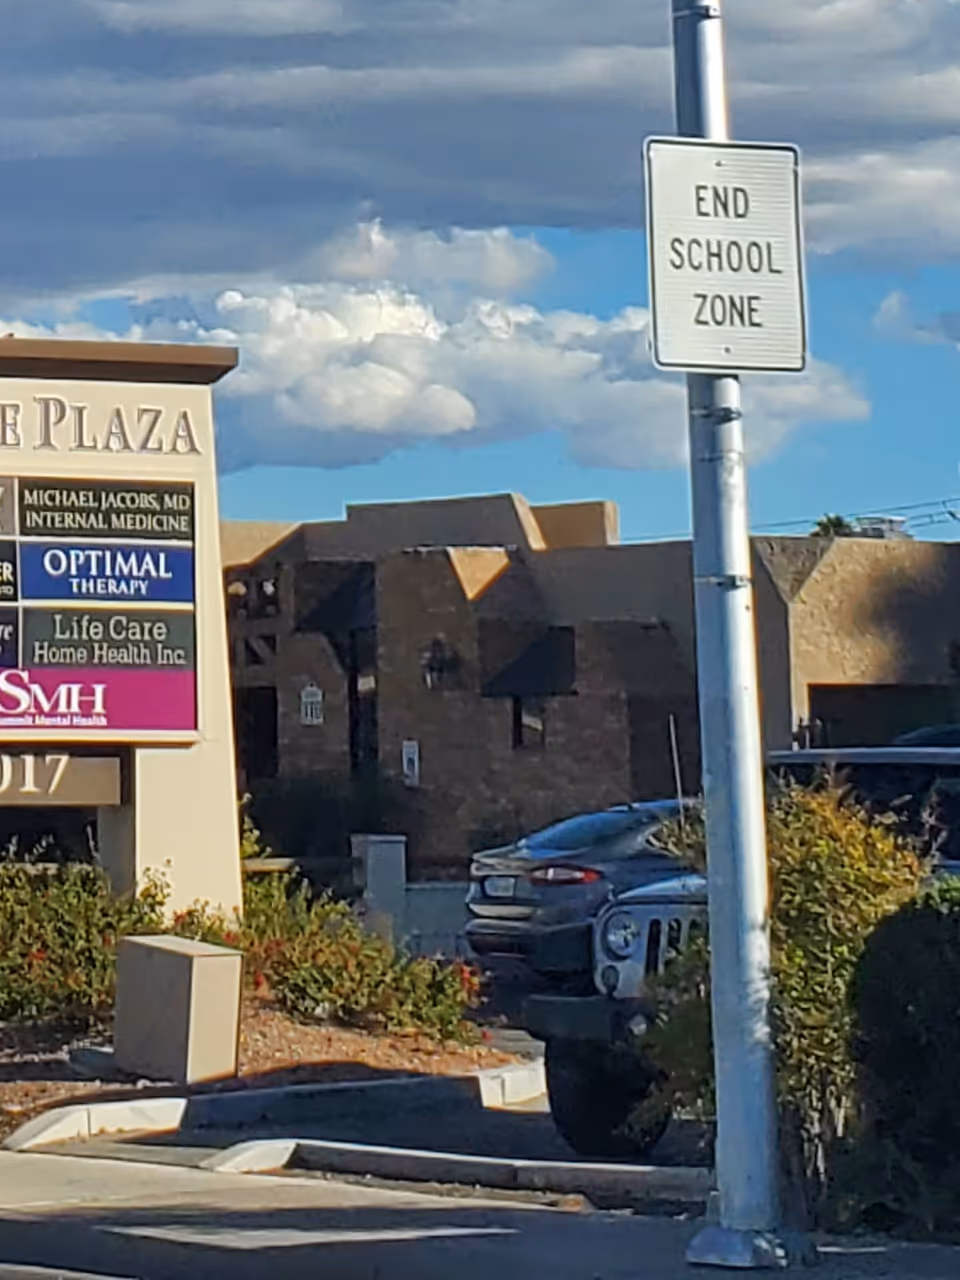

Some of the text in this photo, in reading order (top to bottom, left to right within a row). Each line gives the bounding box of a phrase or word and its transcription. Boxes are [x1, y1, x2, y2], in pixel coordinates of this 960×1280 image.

[694, 185, 749, 218] END
[670, 237, 783, 274] SCHOOL
[694, 293, 763, 328] ZONE
[33, 395, 203, 456] PLAZA
[24, 489, 191, 511] MICHAEL JACOBS, MD
[25, 510, 190, 532] INTERNAL MEDICINE
[43, 549, 173, 578] OPTIMAL
[69, 578, 149, 596] THERAPY
[53, 614, 168, 641] Life Care
[33, 641, 88, 663] Home
[92, 643, 152, 665] Health
